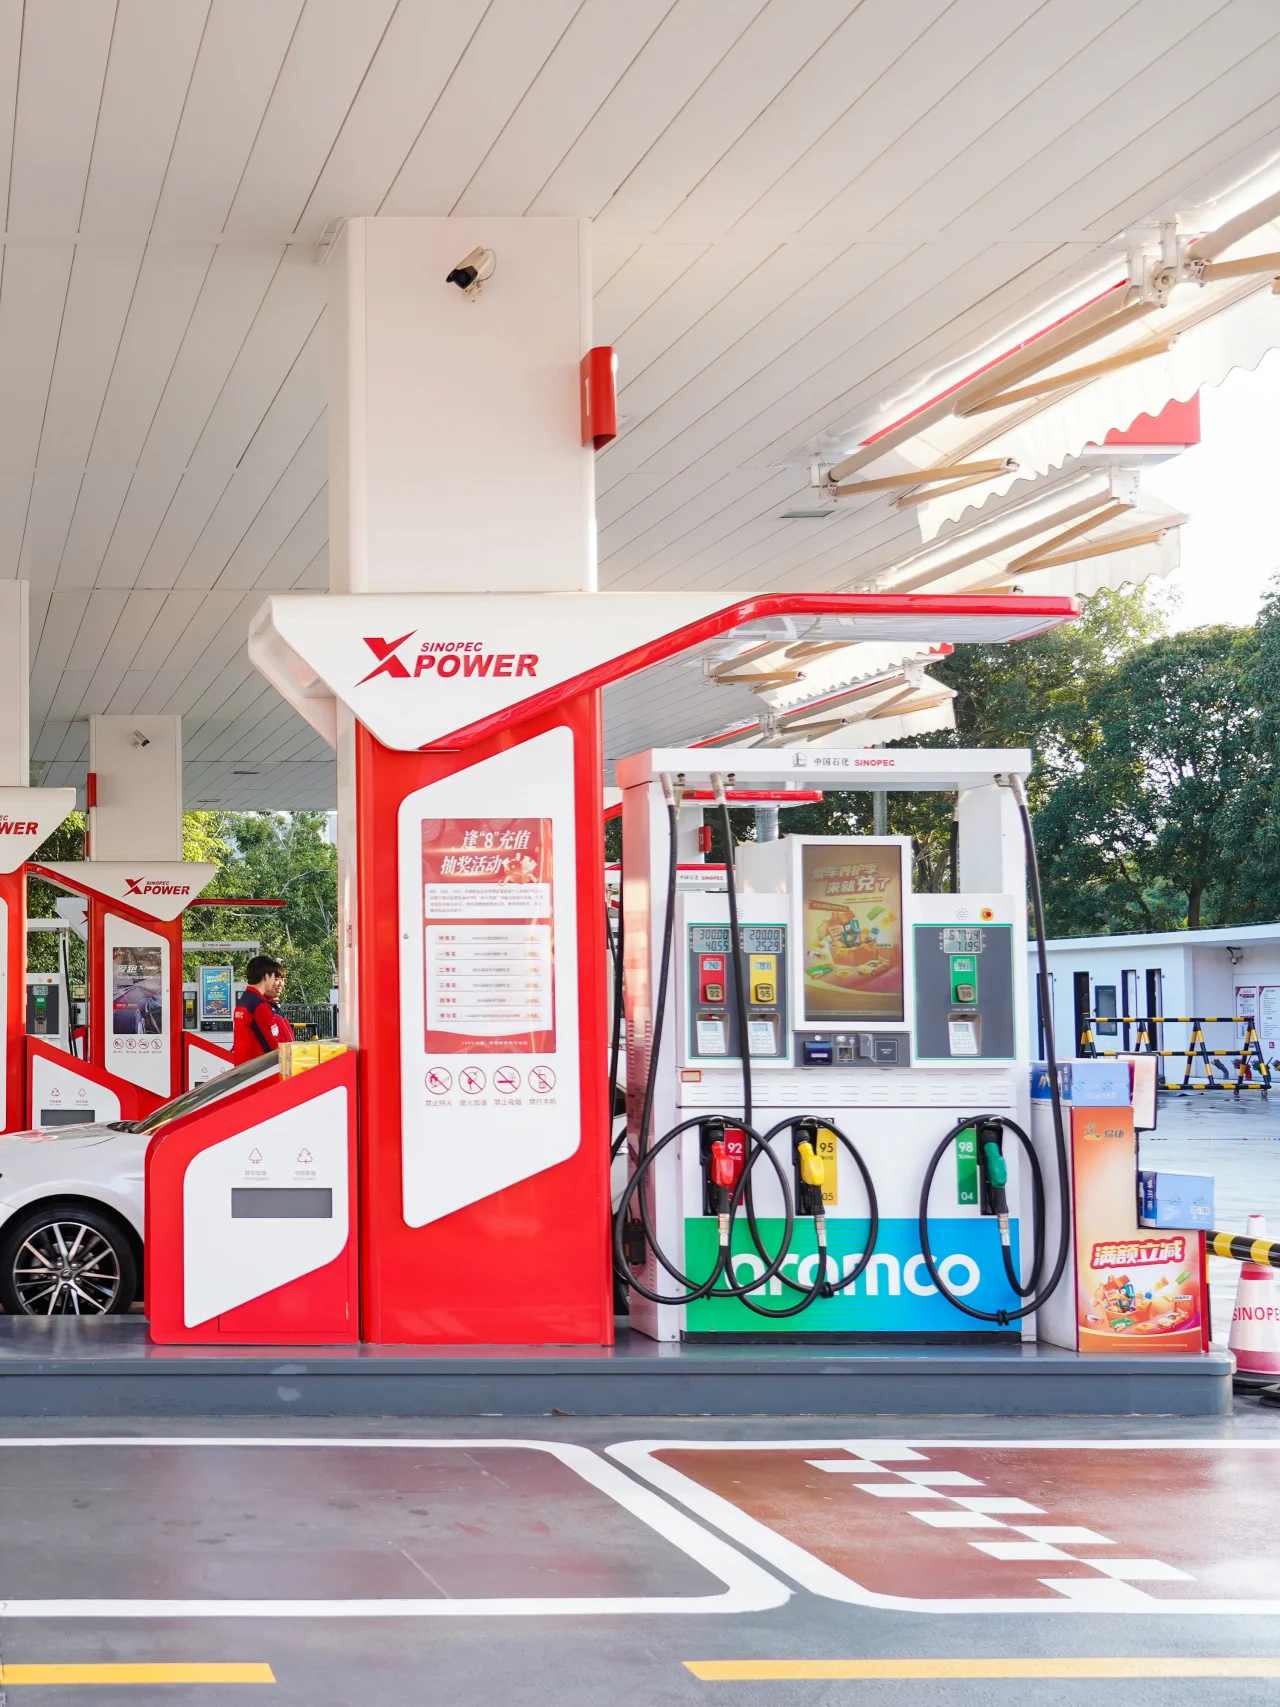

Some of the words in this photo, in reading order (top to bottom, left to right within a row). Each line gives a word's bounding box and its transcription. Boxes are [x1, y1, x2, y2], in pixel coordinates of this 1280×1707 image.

[584, 377, 590, 416] 1
[420, 642, 483, 652] SINOPEC
[814, 757, 849, 766] 中国石化
[441, 854, 501, 875] 抽奖活动
[709, 990, 720, 998] 92
[760, 990, 771, 998] 95
[961, 990, 972, 998] 98
[727, 1142, 743, 1154] 92
[819, 1142, 834, 1153] 95
[958, 1141, 974, 1152] 98
[821, 1192, 834, 1201] 05
[961, 1191, 974, 1201] 04
[1093, 1240, 1183, 1267] 满额立减
[724, 1253, 980, 1297] aramco
